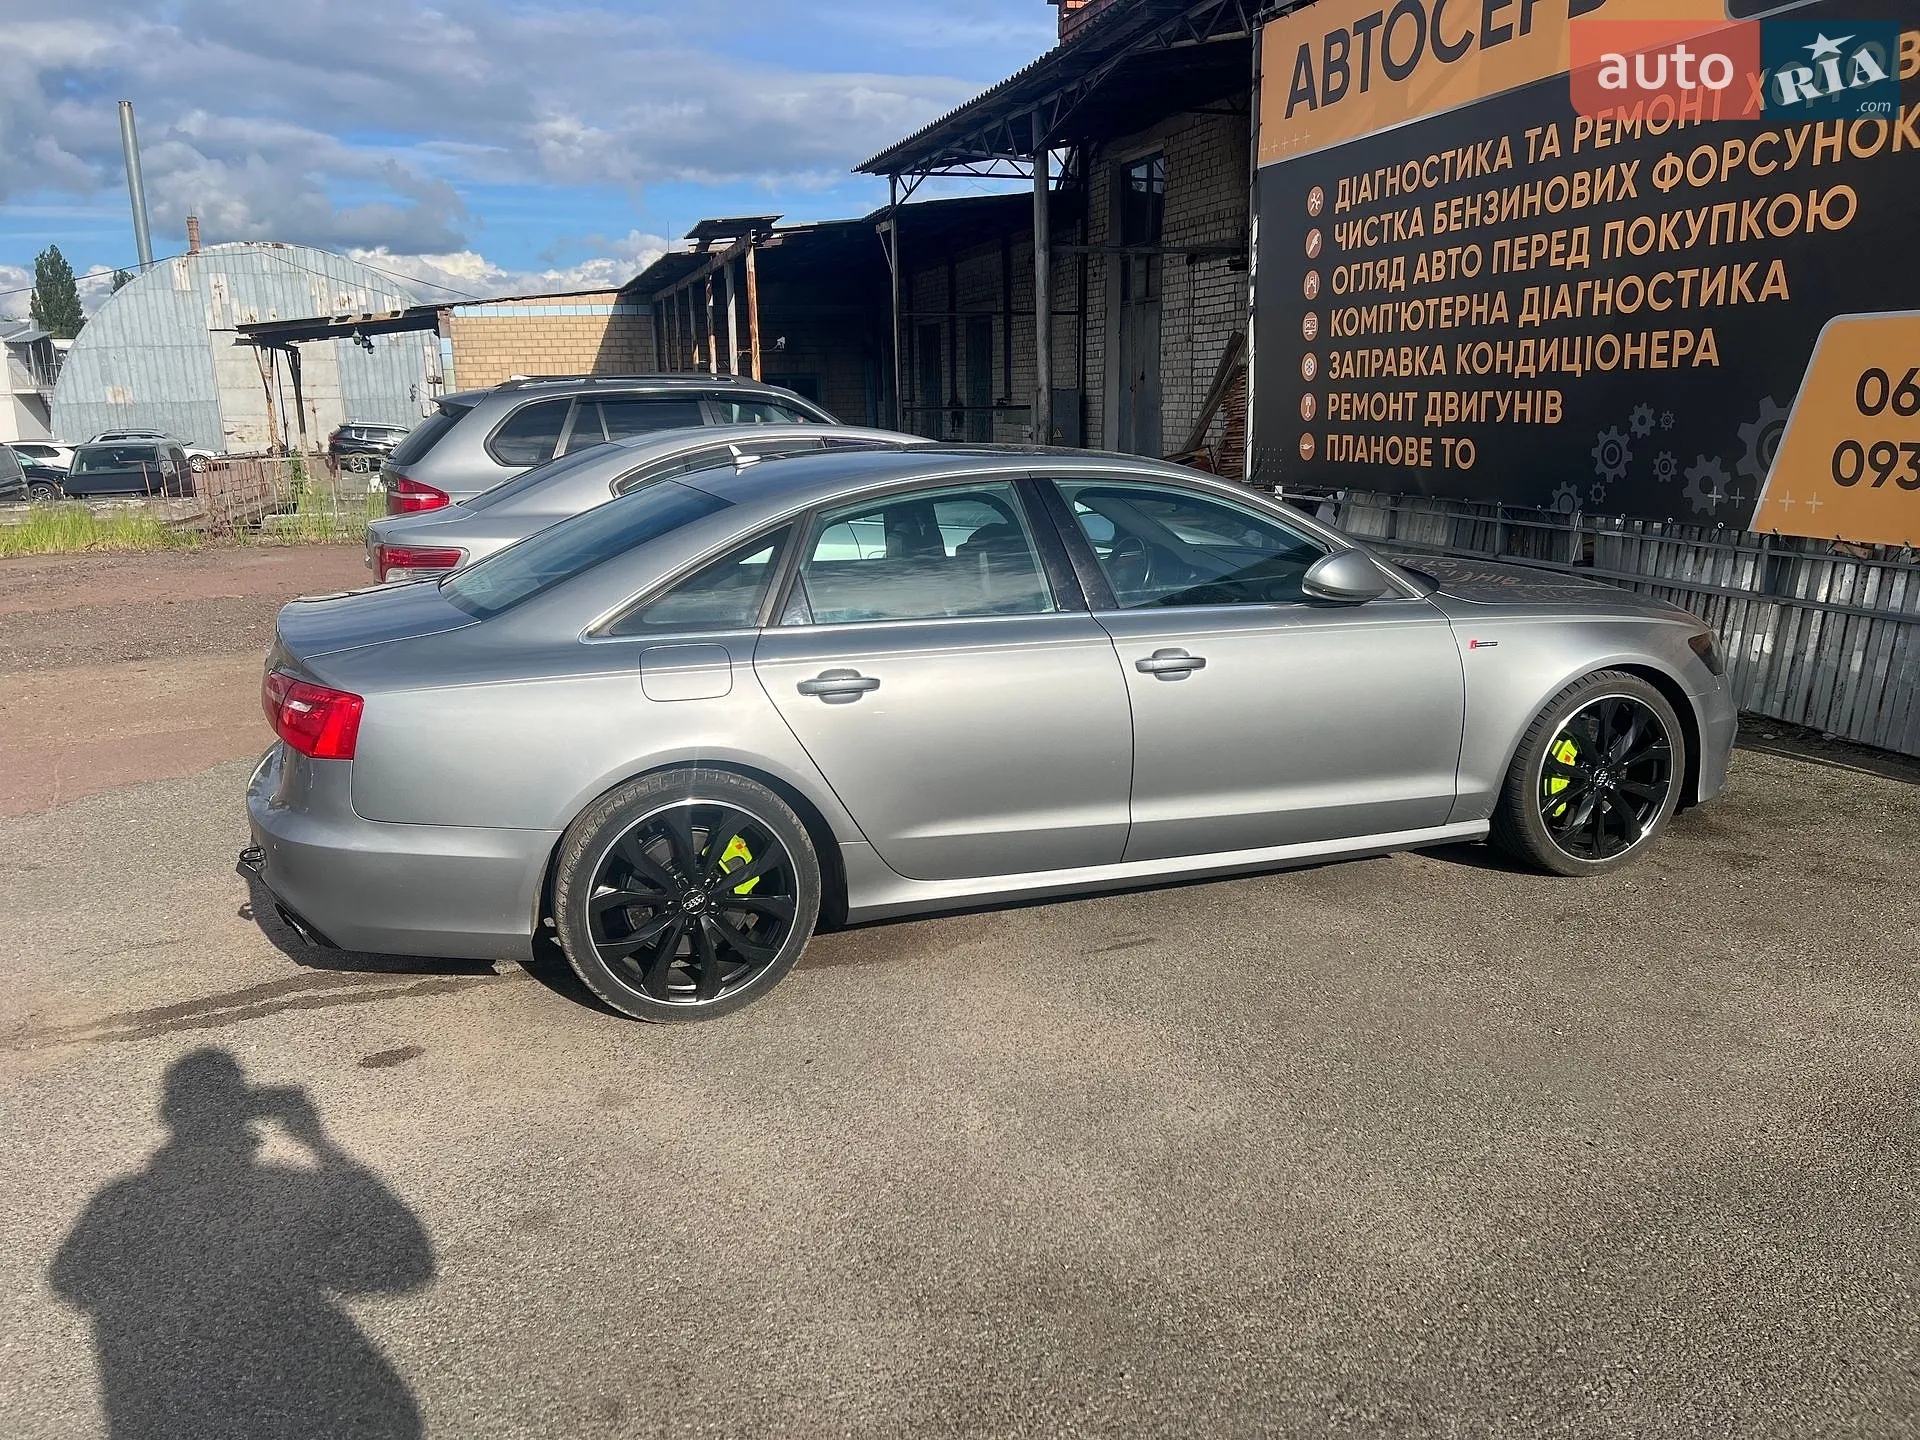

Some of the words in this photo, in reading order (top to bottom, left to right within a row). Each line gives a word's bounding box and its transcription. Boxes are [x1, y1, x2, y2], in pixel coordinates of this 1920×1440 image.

[1284, 0, 1606, 120] АВТОСЕ
[1333, 206, 1424, 252] ЧИСТКА
[1432, 159, 1641, 232] БЕНЗИНОВИХ
[1651, 103, 1920, 194] ФОРСУНОК
[1334, 135, 1513, 213] ДІАГНОСТИКА
[1524, 122, 1562, 165] ТА
[1573, 85, 1724, 154] РЕМОНТ
[1331, 250, 1406, 296] ОГЛЯД
[1413, 235, 1483, 286] АВТО
[1491, 225, 1591, 276] ПЕРЕД
[1602, 184, 1859, 261] ПОКУПКОЮ
[1329, 290, 1509, 338] КОМП'ЮТЕРНА
[1518, 259, 1790, 329] ДІАГНОСТИКА
[1328, 344, 1448, 380] ЗАПРАВКА
[1455, 327, 1721, 378] КОНДИЦІОНЕРА
[1327, 391, 1418, 422] РЕМОНТ
[1424, 389, 1563, 427] ДВИГУНІВ
[1855, 367, 1920, 417] 06
[1325, 434, 1433, 468] ПЛАНОВЕ
[1440, 437, 1476, 470] ТО
[1831, 439, 1920, 491] 093
